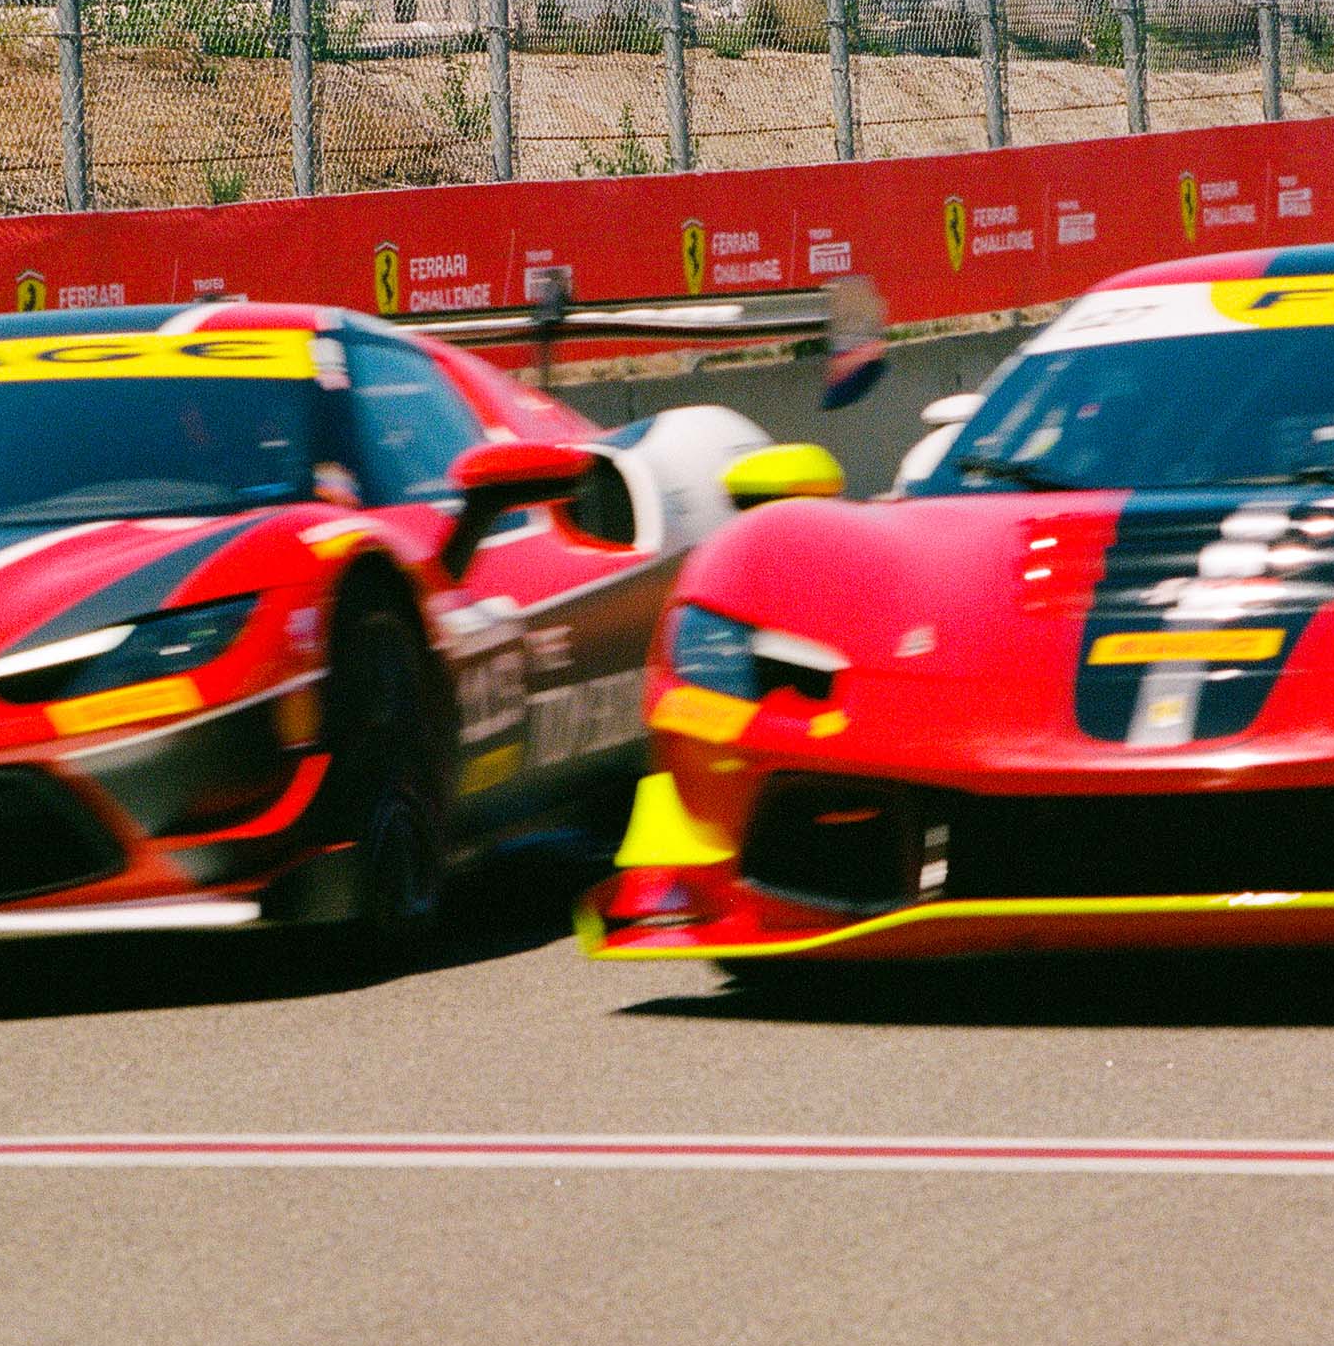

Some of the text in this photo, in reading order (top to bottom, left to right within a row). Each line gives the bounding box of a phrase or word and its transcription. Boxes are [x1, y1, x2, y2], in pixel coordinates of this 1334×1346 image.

[410, 253, 468, 280] FERRARI
[58, 284, 124, 308] FERRARI
[410, 283, 491, 312] CHALLENGE
